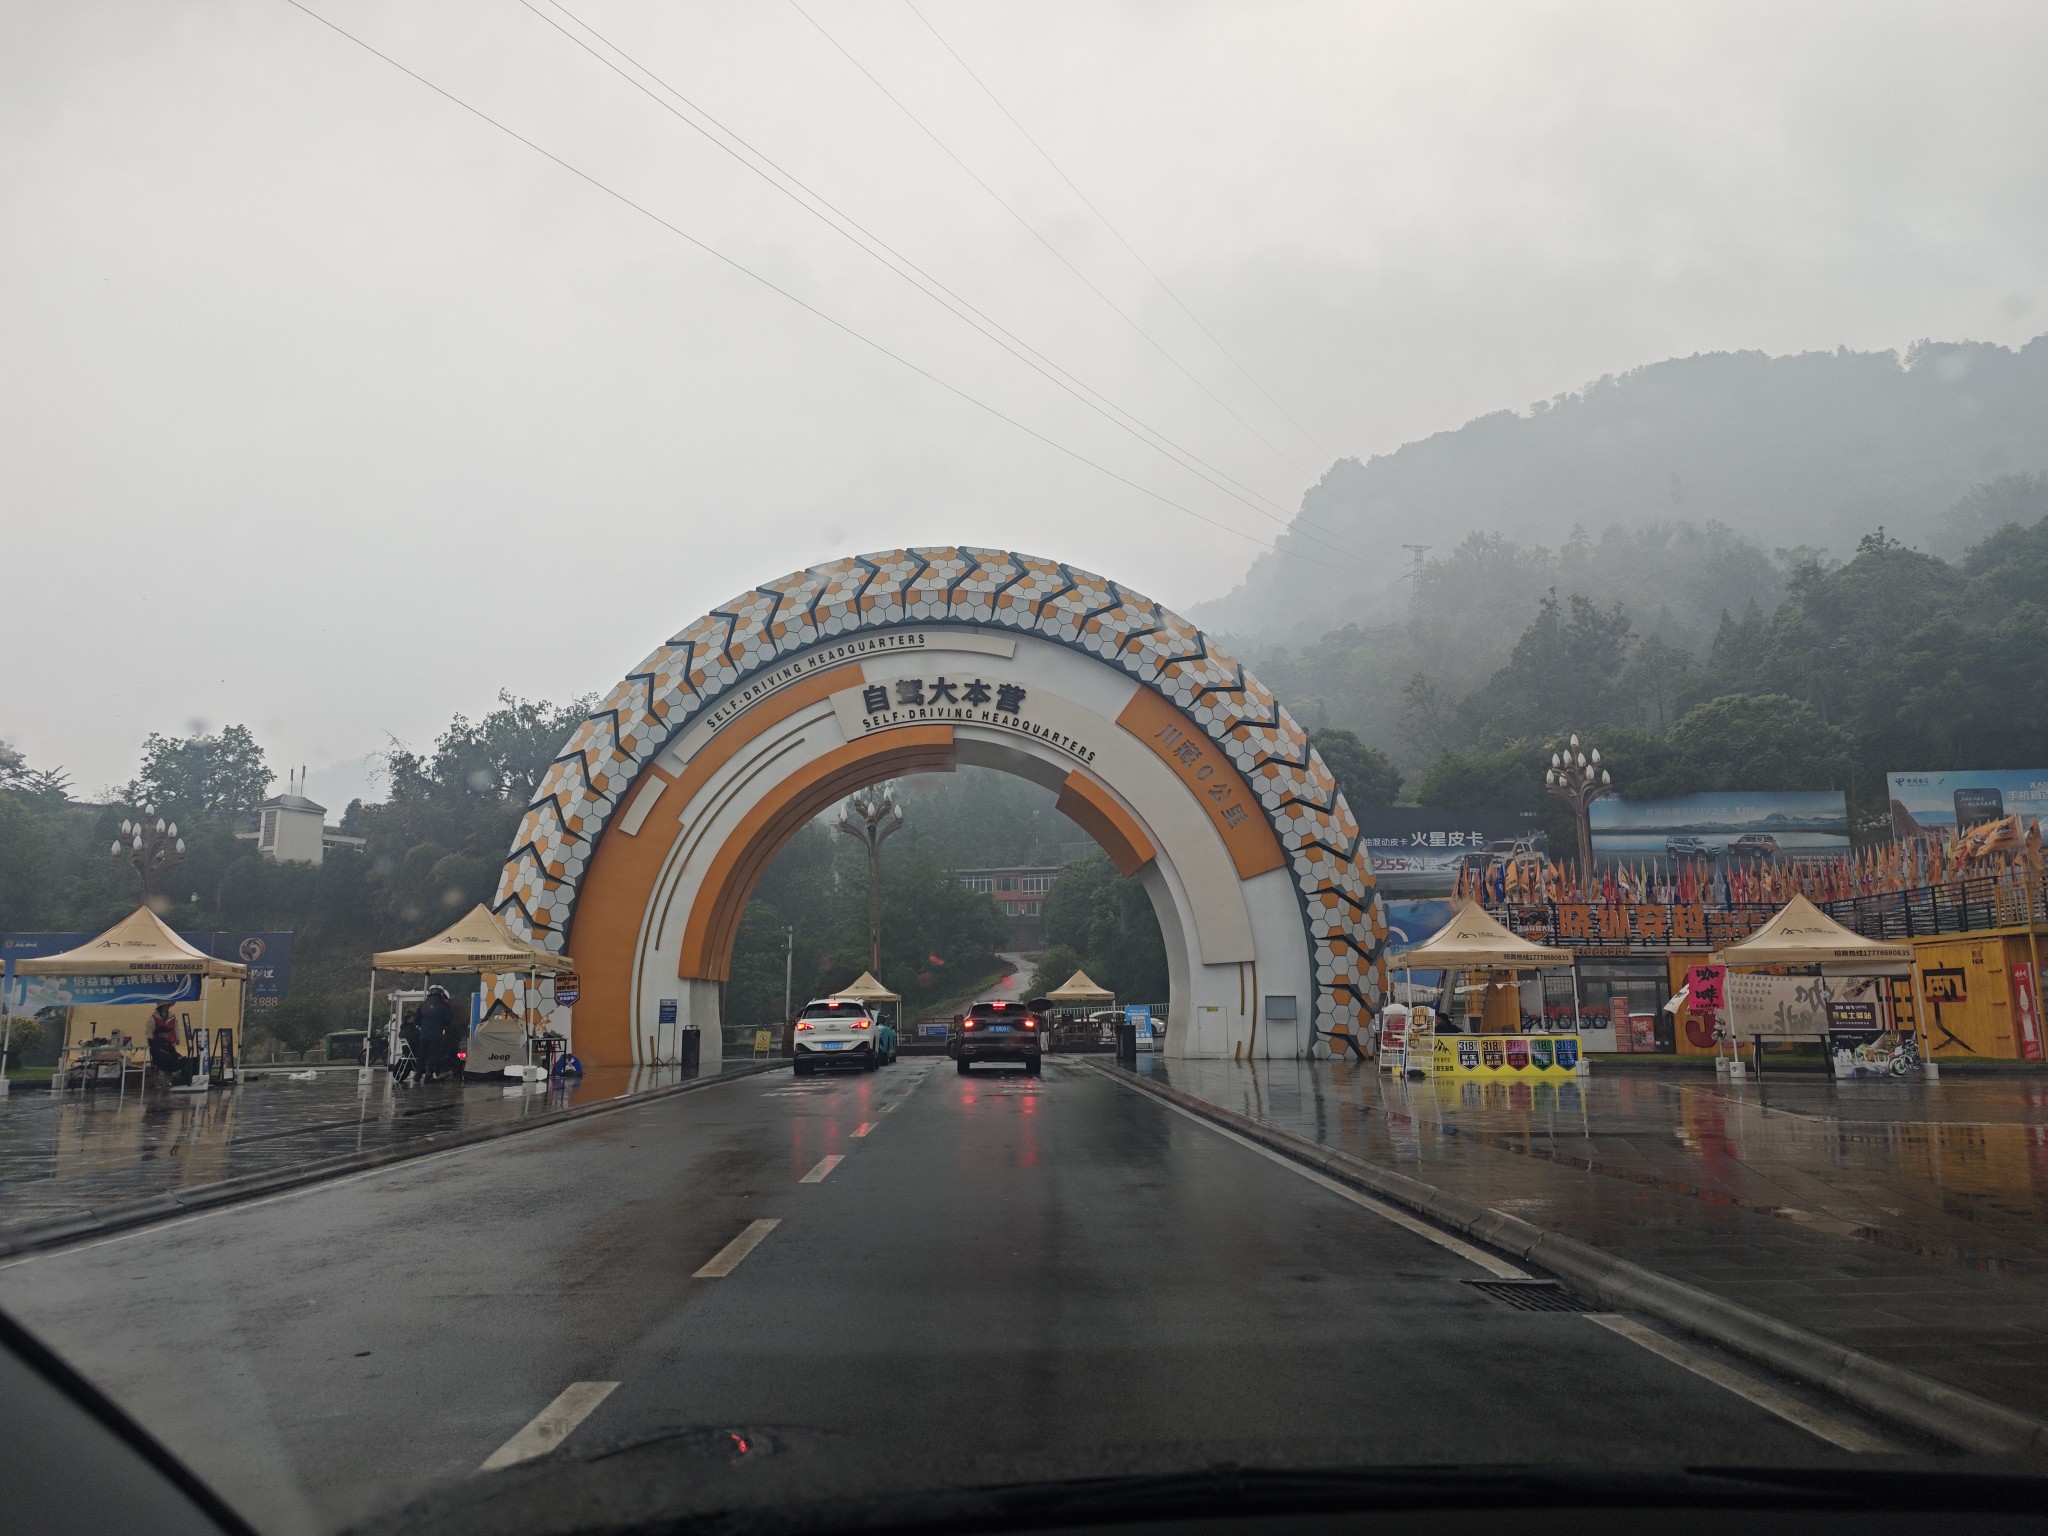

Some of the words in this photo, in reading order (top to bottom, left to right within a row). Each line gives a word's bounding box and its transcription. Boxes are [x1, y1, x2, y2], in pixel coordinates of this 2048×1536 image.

[808, 633, 925, 667] HEADQUARTERS
[863, 677, 1027, 714] 自驾大本营
[981, 711, 1096, 762] HEADQUARTERS
[1410, 831, 1484, 847] 火星皮卡
[1558, 905, 1706, 938] 晓纵穿越
[1503, 953, 1569, 961] 招商热线17778680835
[1834, 949, 1910, 957] 招商热线17778680835
[1695, 967, 1720, 1003] 咖啡
[1459, 1042, 1474, 1050] 318
[1483, 1042, 1498, 1050] 318
[1507, 1041, 1522, 1050] 318
[1532, 1041, 1547, 1050] 318
[1556, 1041, 1572, 1050] 318
[488, 1053, 511, 1062] Jeep
